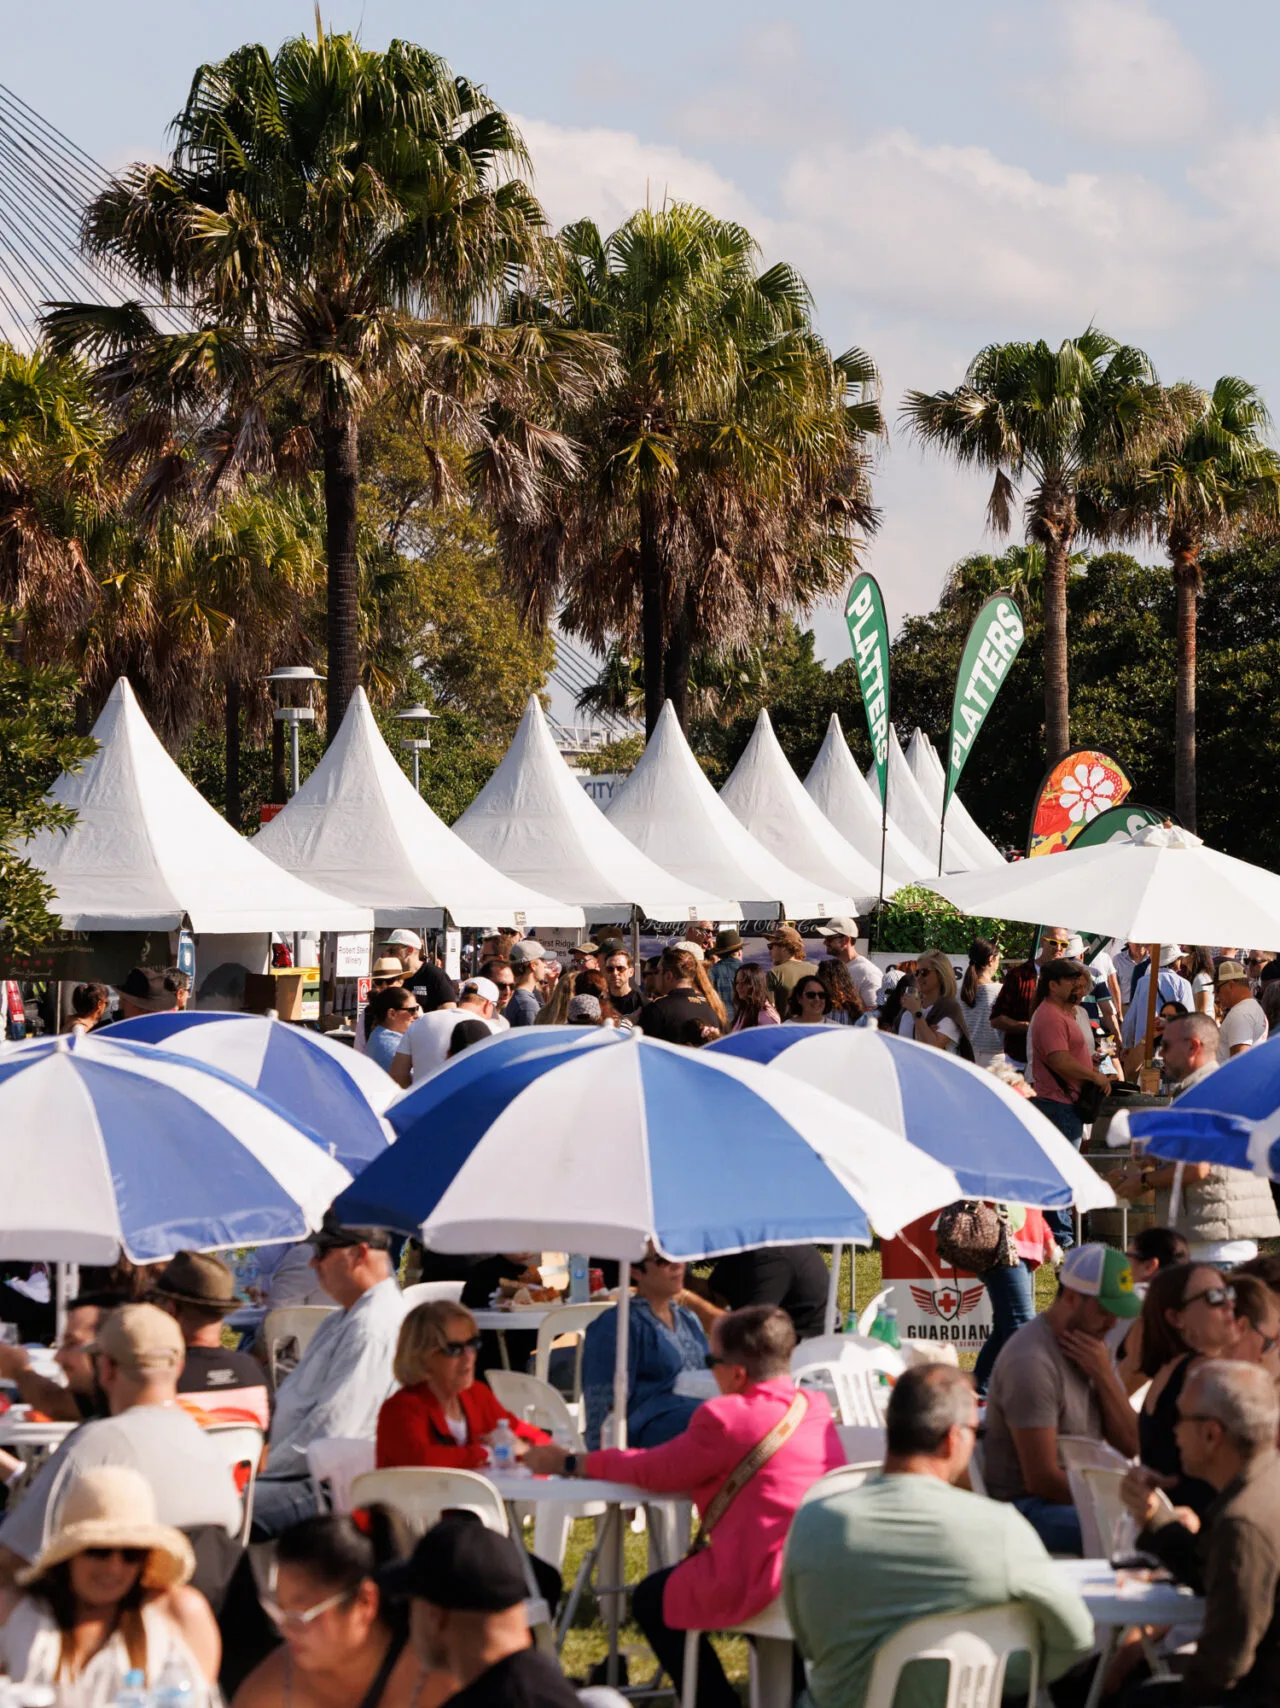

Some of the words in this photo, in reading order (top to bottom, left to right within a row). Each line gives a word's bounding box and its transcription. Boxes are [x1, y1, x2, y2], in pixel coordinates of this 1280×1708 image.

[847, 583, 888, 766] PLATTERS
[951, 602, 1026, 770] PLATTERS
[555, 939, 576, 949] Ridge
[907, 1324, 990, 1340] GUARDIAN
